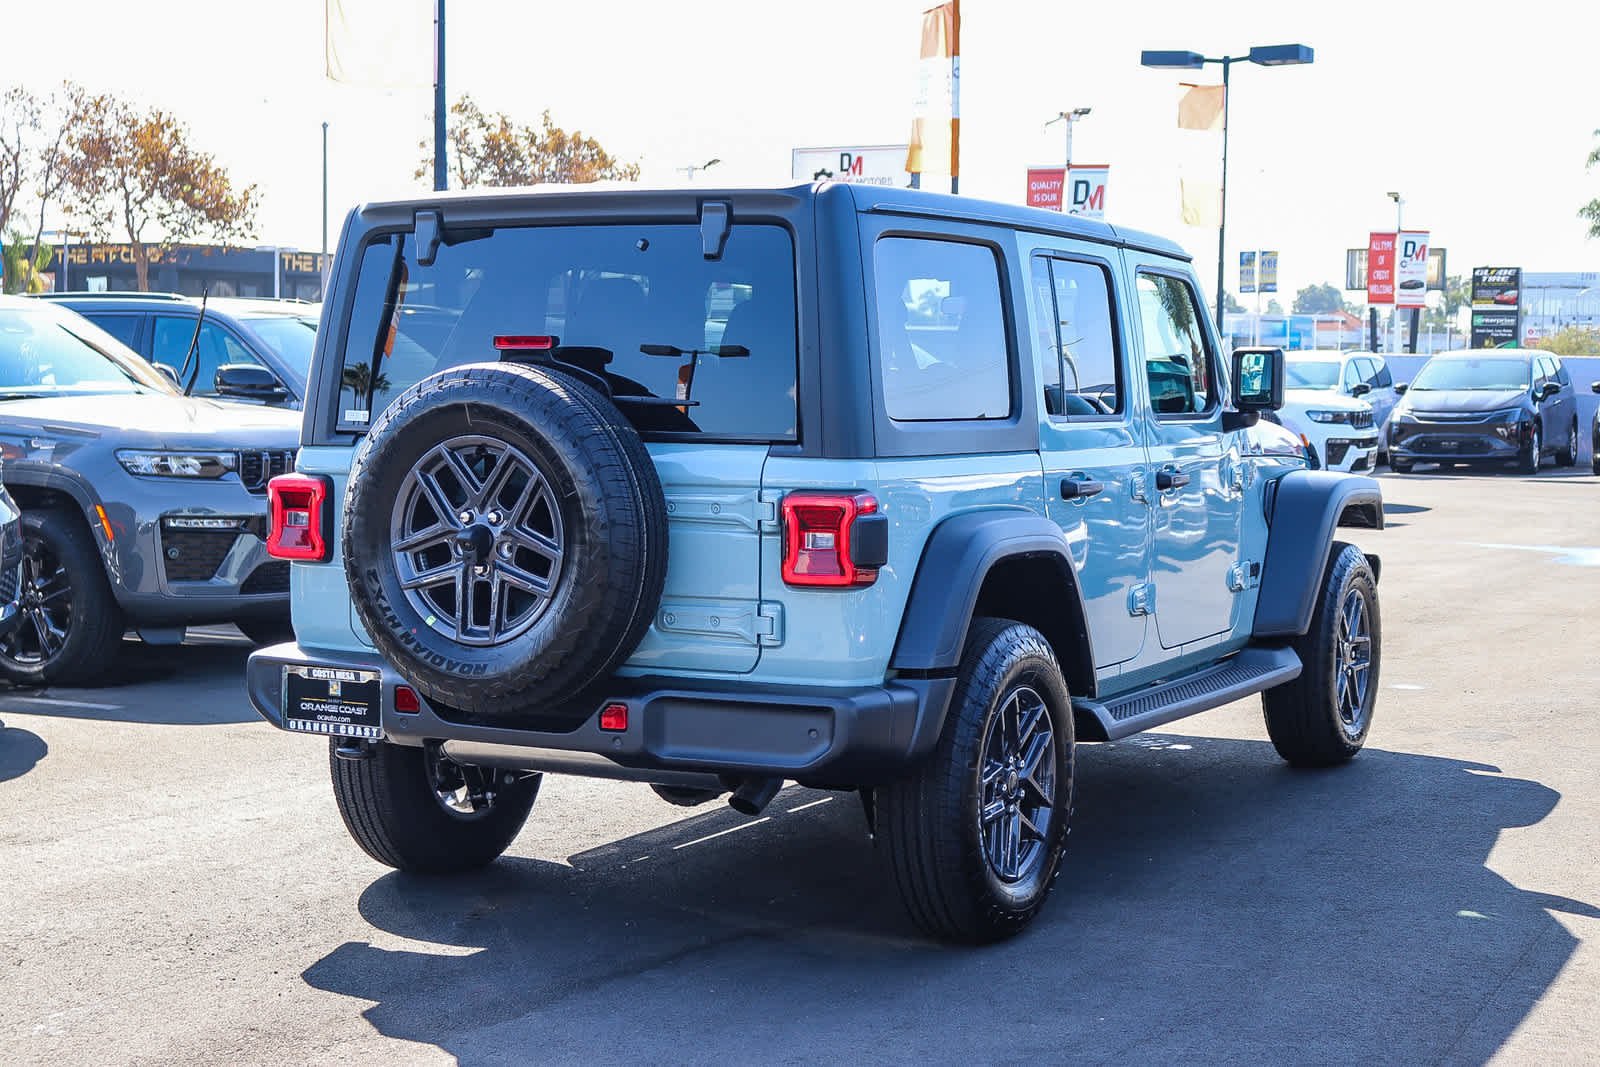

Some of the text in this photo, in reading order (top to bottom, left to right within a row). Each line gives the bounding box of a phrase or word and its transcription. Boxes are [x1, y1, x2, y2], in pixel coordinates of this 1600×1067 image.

[840, 152, 863, 176] DM
[1031, 181, 1062, 190] QUALITY
[1033, 192, 1058, 202] IS OUR
[1073, 180, 1105, 210] DM
[55, 247, 88, 264] THE
[1403, 240, 1427, 262] DM
[281, 253, 313, 272] THE
[400, 631, 489, 675] ROADIAN
[312, 668, 355, 681] COSTA MESA
[300, 702, 369, 716] ORANGE COAST
[317, 714, 351, 723] ocauto.com
[289, 720, 378, 737] ORANGE COAST
